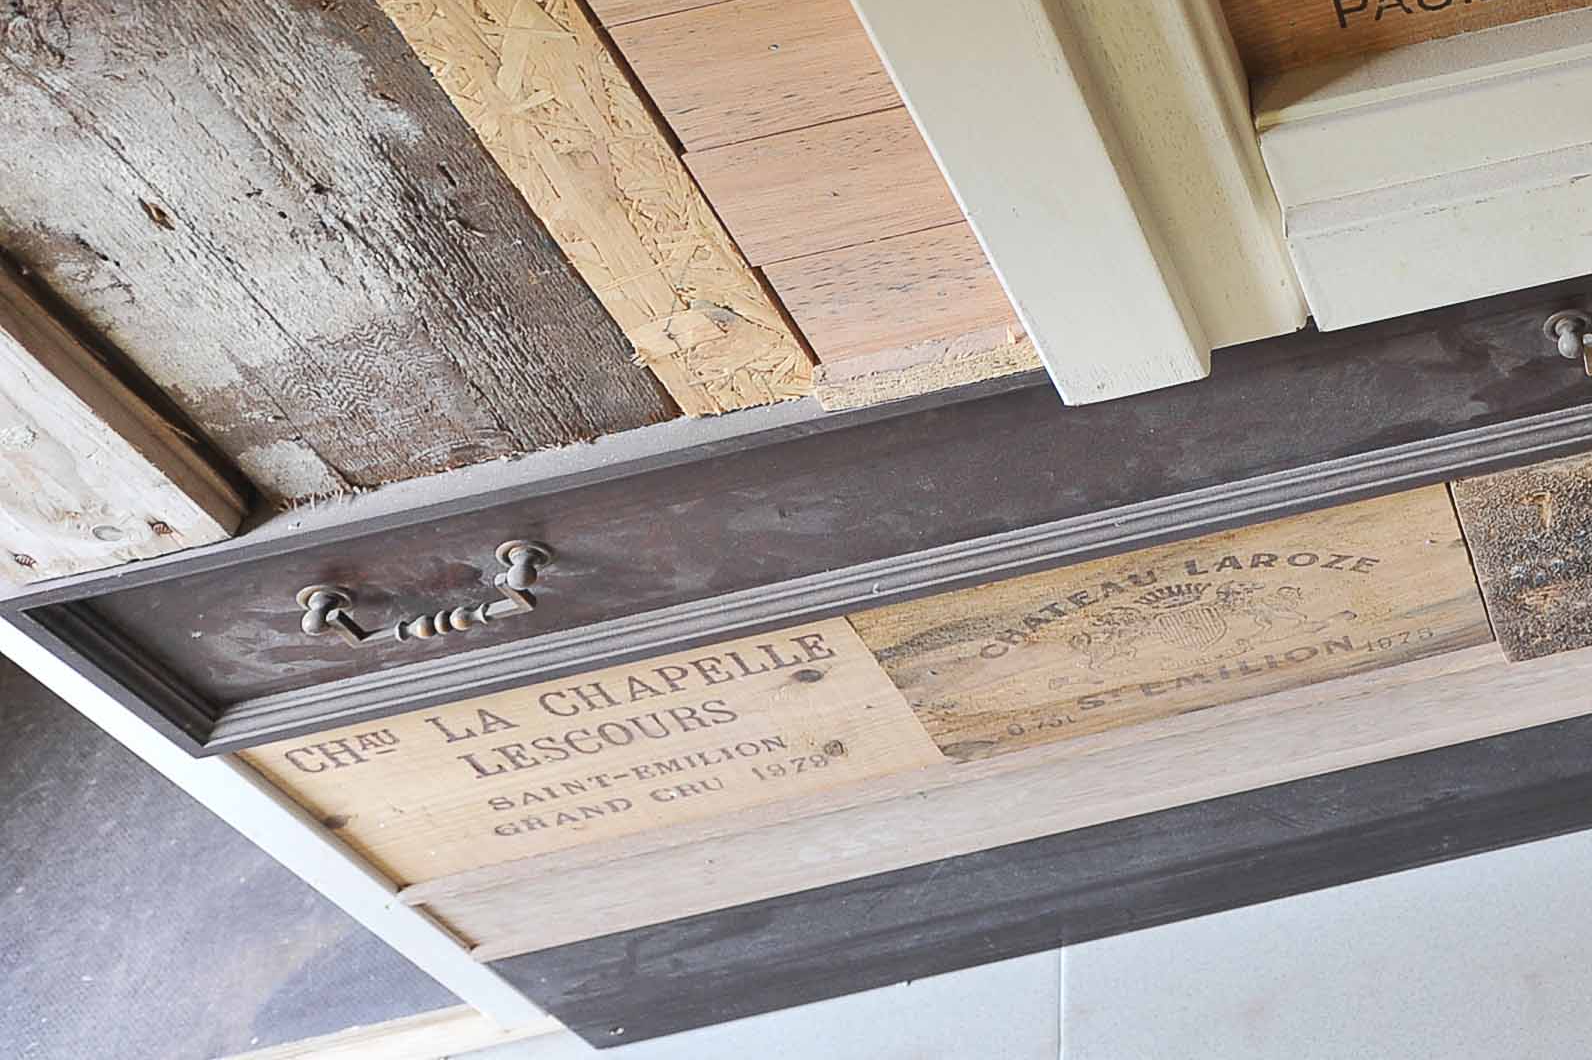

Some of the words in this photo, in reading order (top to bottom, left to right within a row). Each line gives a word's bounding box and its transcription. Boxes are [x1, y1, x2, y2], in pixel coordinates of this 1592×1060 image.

[979, 570, 1157, 659] CHATEAU
[1184, 551, 1381, 577] LAROZE
[424, 708, 517, 743] LA
[539, 632, 837, 718] CHAPELLE
[457, 699, 741, 780] LESCOURS
[486, 735, 788, 812] SAINT-EMILION
[493, 797, 635, 838] GRAND
[657, 776, 725, 804] CRU
